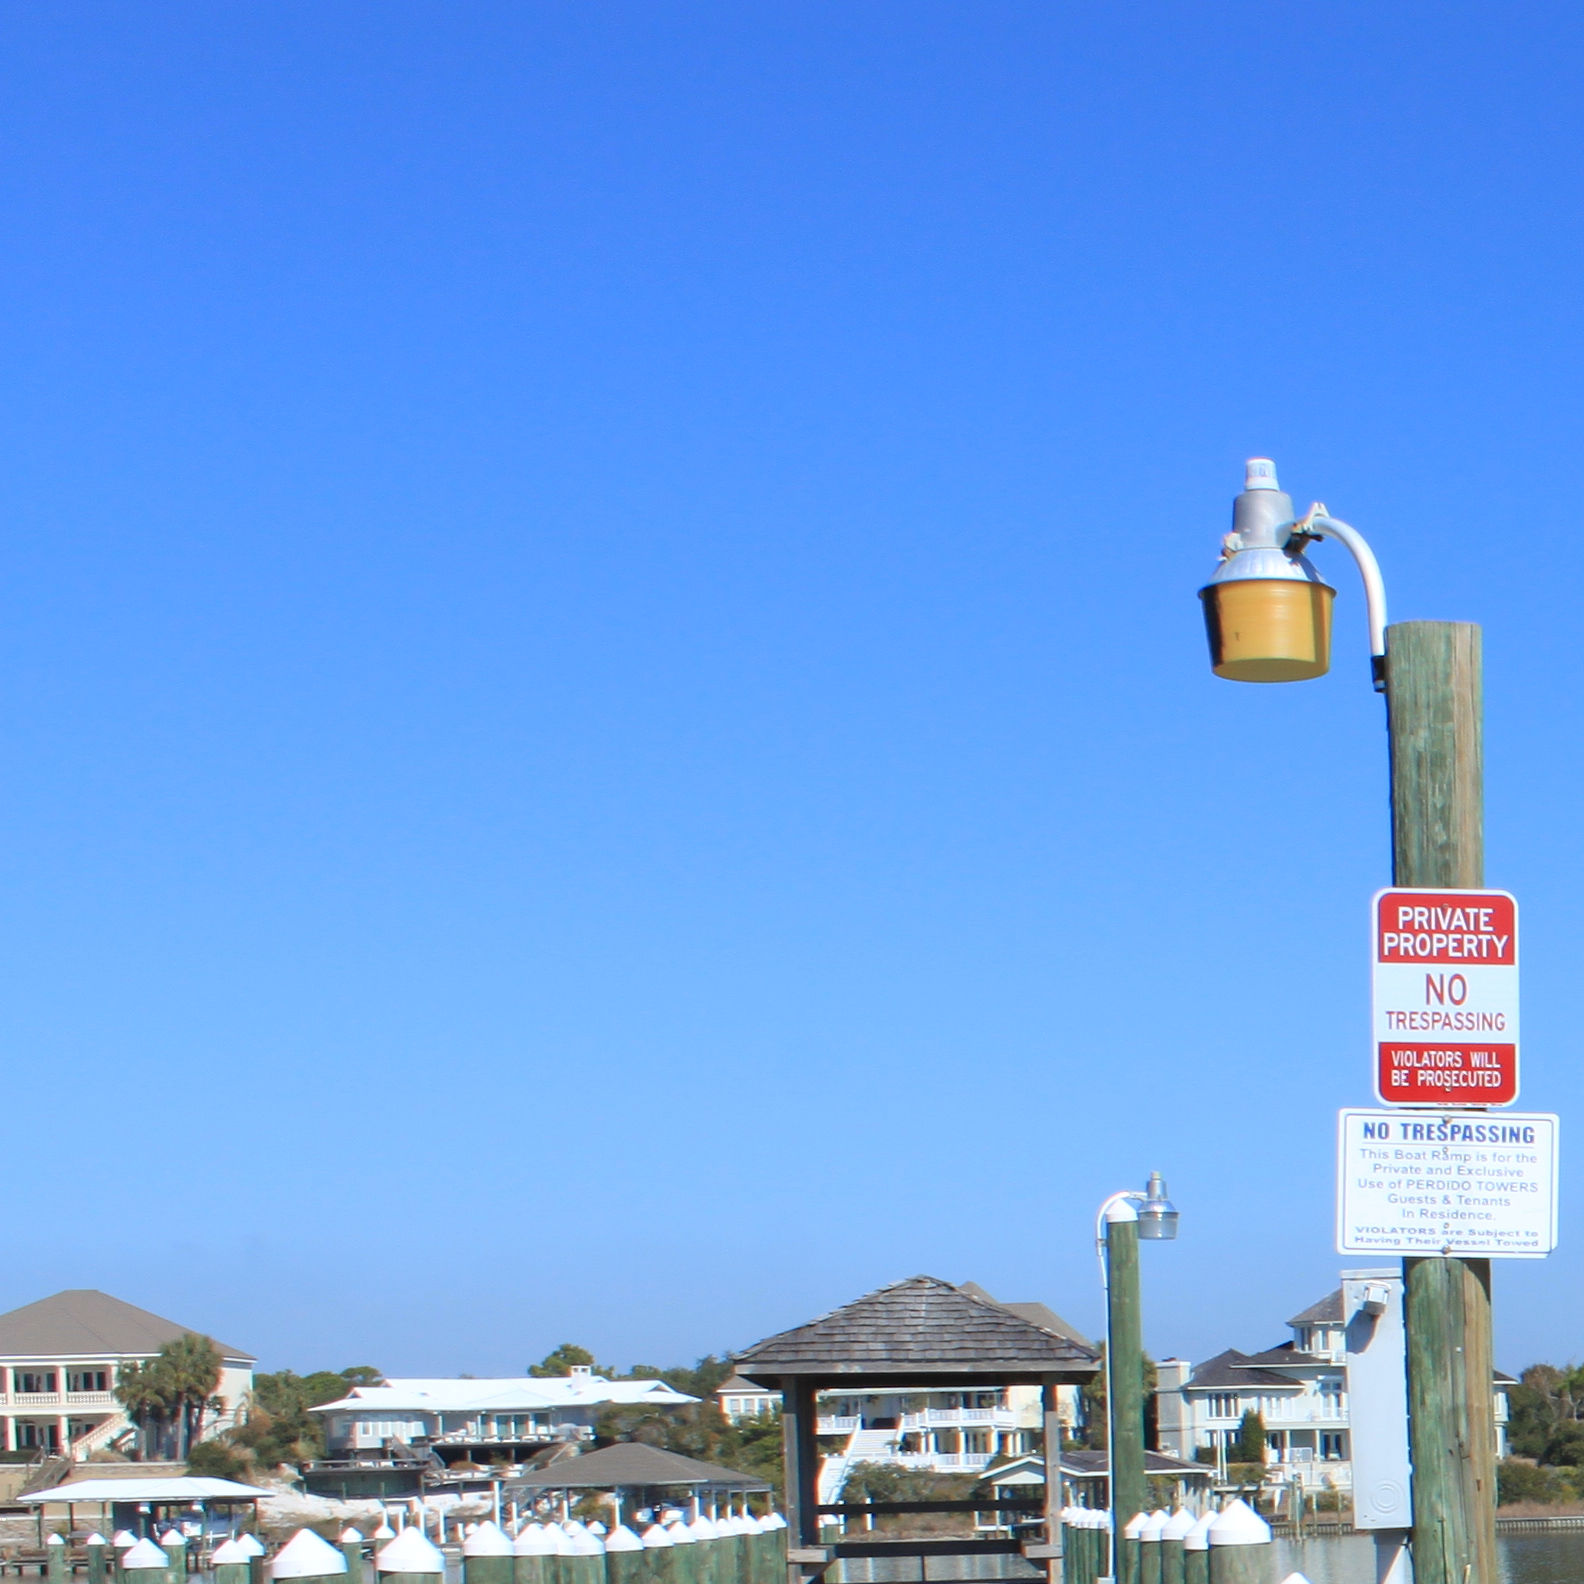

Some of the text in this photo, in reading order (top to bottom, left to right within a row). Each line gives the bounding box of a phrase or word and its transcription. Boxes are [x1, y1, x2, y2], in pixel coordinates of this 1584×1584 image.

[1398, 907, 1494, 931] PRIVATE
[1383, 933, 1508, 958] PROPERTY
[1425, 973, 1467, 1005] NO
[1386, 1011, 1506, 1031] TRESPASSING
[1392, 1051, 1501, 1068] VIOLATORS WILL
[1391, 1070, 1501, 1087] BE PROSECUTED
[1363, 1122, 1535, 1144] NO TRESPASSING
[1360, 1148, 1538, 1164] This Boat Ramp is for the
[1373, 1163, 1524, 1177] Private and Exclusive
[1358, 1179, 1538, 1192] Use of PERDIDO TOWERS
[1388, 1193, 1511, 1206] Guests & Tenants
[1402, 1208, 1496, 1220] In Residence.
[1354, 1236, 1401, 1245] Having
[1355, 1227, 1436, 1235] VIOLATORS
[1468, 1229, 1520, 1238] Subject
